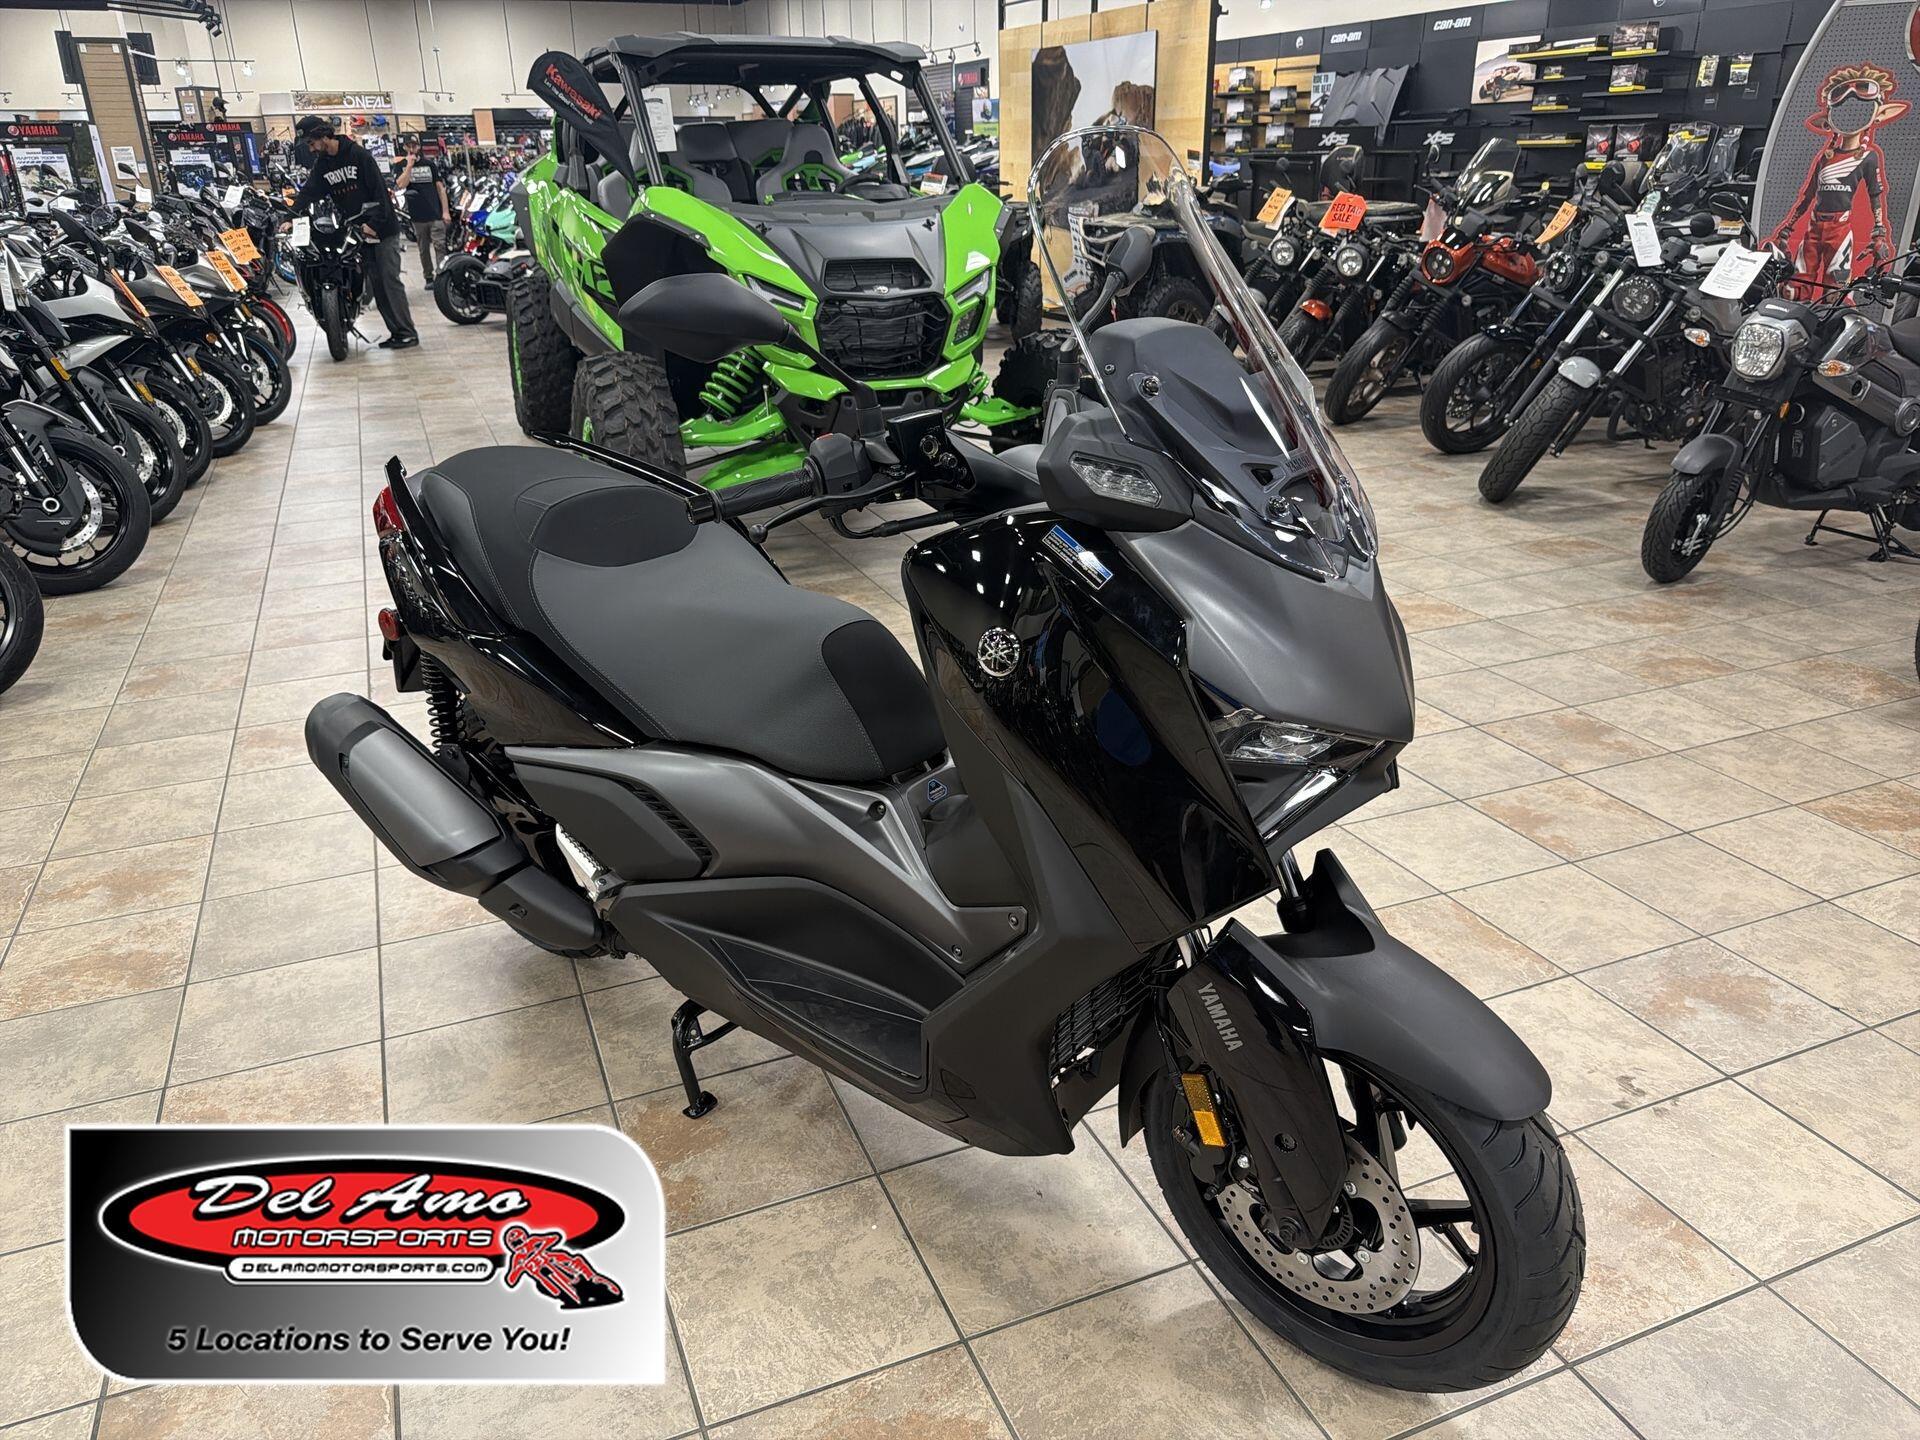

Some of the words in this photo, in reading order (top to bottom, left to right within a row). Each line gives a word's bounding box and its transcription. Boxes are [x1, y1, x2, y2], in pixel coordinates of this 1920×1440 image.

[1433, 17, 1472, 31] can-am
[1330, 31, 1362, 43] can-am
[546, 64, 603, 119] Kawasaki
[19, 125, 59, 136] YAMAHA
[176, 133, 205, 142] YAMAHA
[323, 168, 346, 185] TROY
[344, 166, 358, 179] LEE
[1819, 184, 1853, 192] HONDA
[1331, 203, 1346, 213] RED
[1332, 213, 1352, 223] SALE
[1198, 982, 1244, 1052] YAMAHA
